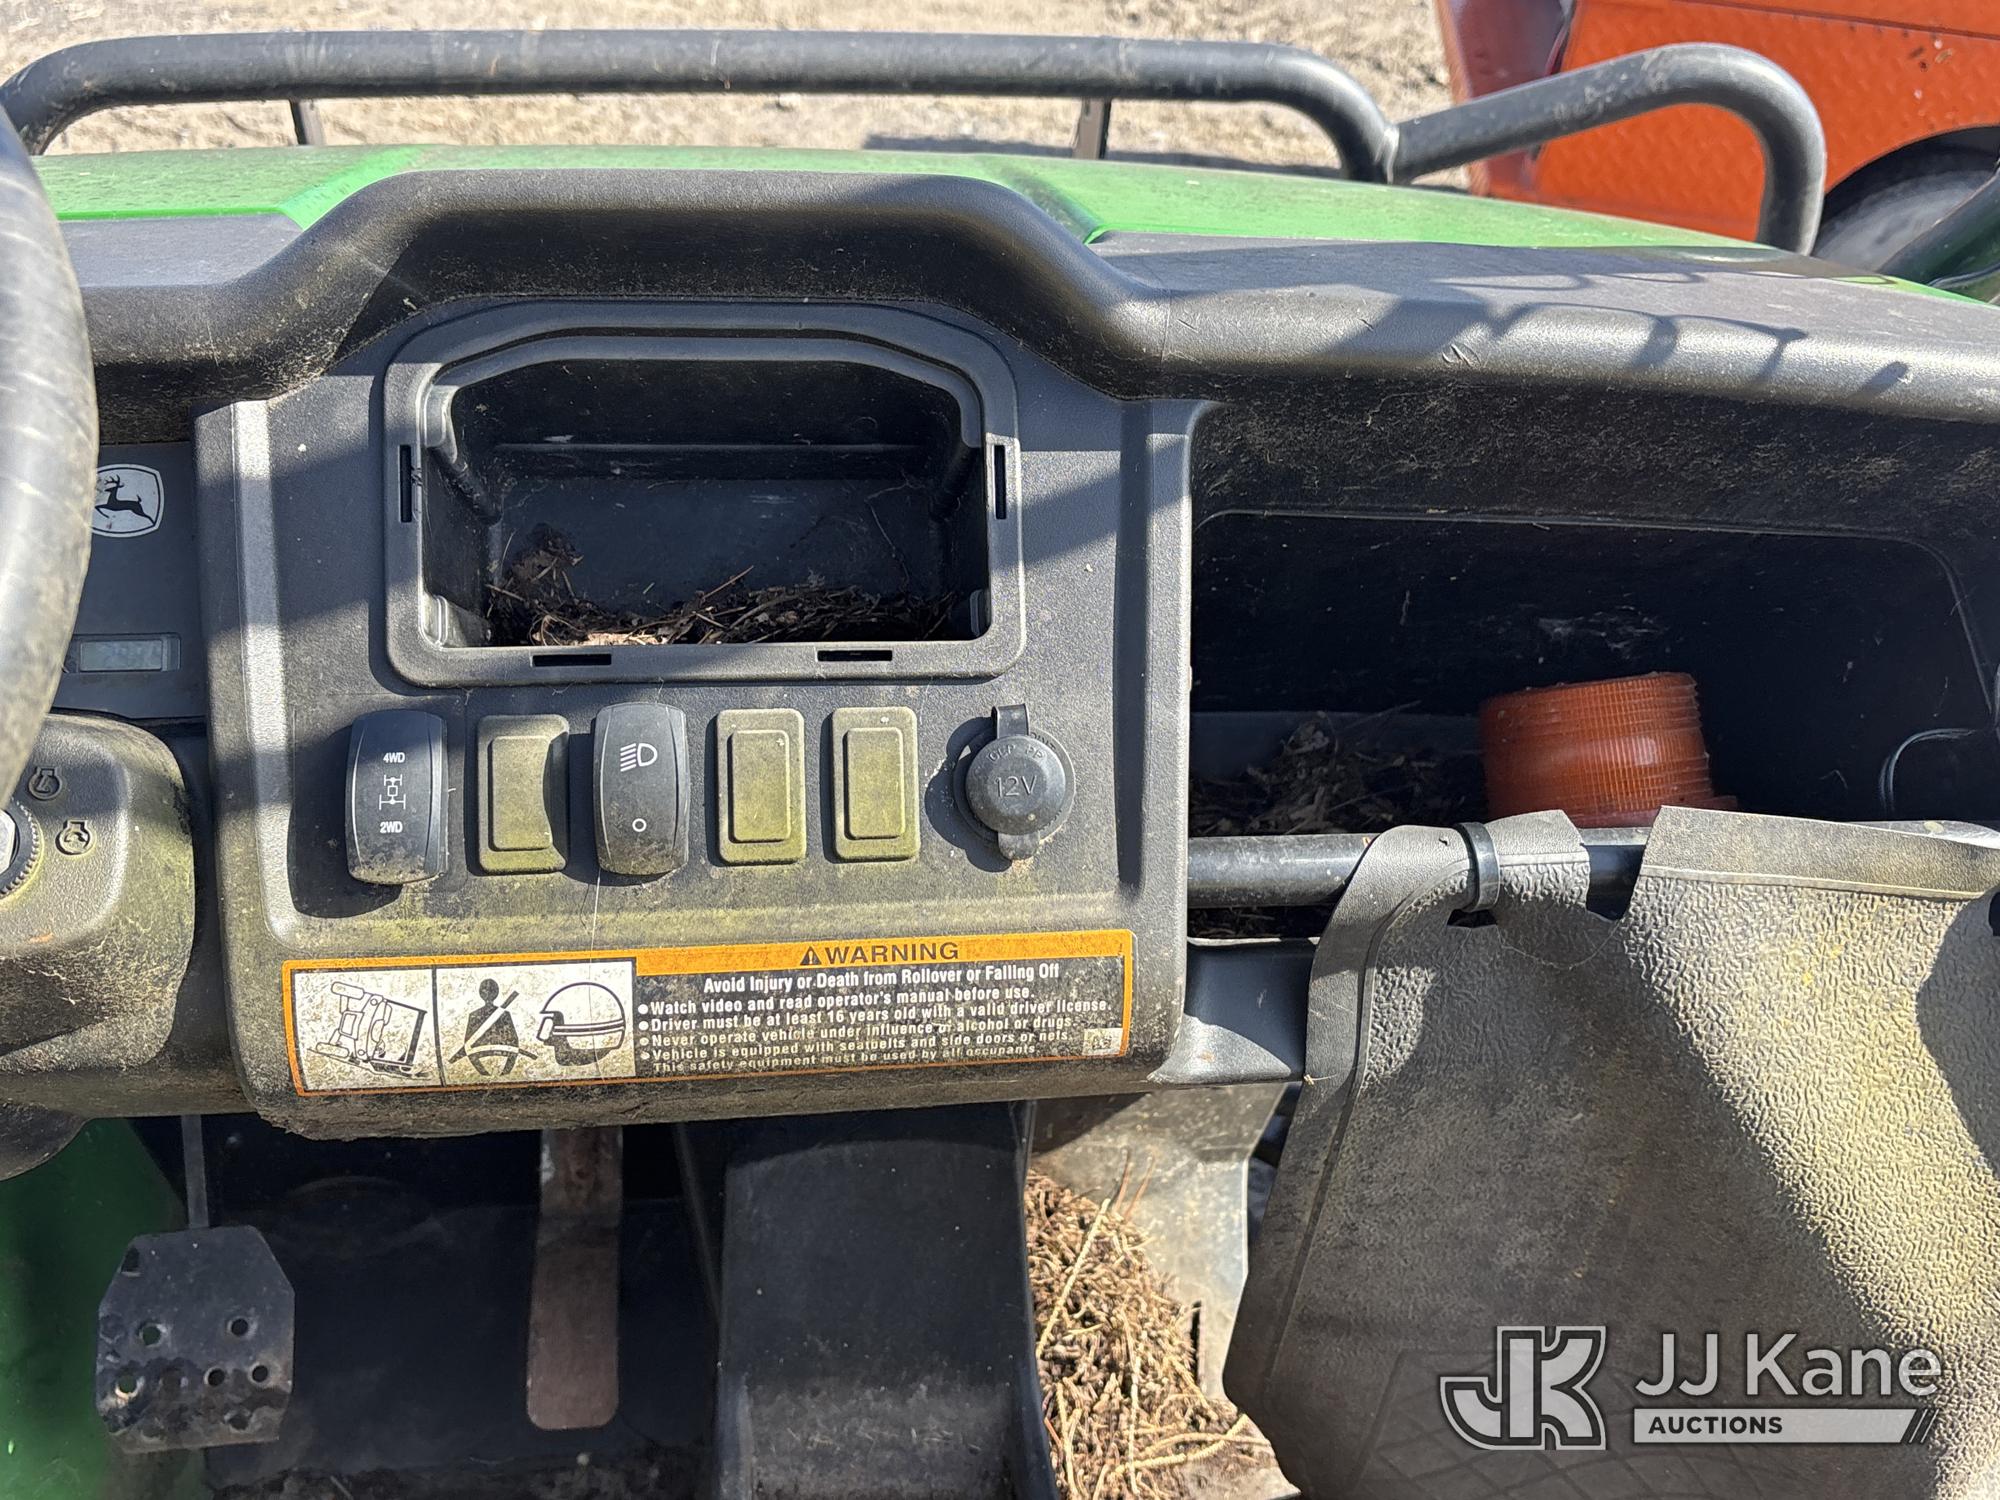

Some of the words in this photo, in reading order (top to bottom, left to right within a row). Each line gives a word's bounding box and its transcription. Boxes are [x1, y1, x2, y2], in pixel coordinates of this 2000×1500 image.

[383, 752, 405, 764] 4WD
[994, 775, 1037, 798] 12V
[380, 821, 403, 834] 2WD
[825, 942, 958, 965] WARNING
[704, 976, 745, 993] Avoid
[750, 975, 792, 993] Injury
[796, 976, 813, 990] or
[817, 971, 859, 988] Death
[863, 970, 897, 986] from
[902, 967, 961, 985] Rollover
[966, 967, 981, 982] or
[985, 964, 1035, 982] Falling
[1039, 963, 1060, 978] Off
[650, 1000, 697, 1016] Watch
[702, 998, 743, 1013] video
[747, 996, 774, 1011] and
[779, 995, 813, 1009] read
[818, 991, 891, 1010] operator's
[896, 987, 949, 1004] manual
[954, 986, 999, 1001] before
[1005, 987, 1035, 999] use.
[652, 1018, 698, 1032] Driver
[703, 1016, 738, 1029] must
[743, 1014, 760, 1027] be
[767, 1012, 781, 1025] at
[786, 1010, 822, 1026] least
[827, 1009, 845, 1023] 16
[849, 1010, 890, 1028] years
[894, 1006, 916, 1019] old
[922, 1004, 951, 1019] with
[956, 1006, 964, 1017] a
[970, 1001, 1004, 1016] valid
[1010, 1000, 1052, 1015] driver
[1056, 998, 1112, 1012] license.
[652, 1034, 694, 1047] Never
[701, 1028, 757, 1048] operate
[762, 1025, 815, 1042] vehicle
[820, 1026, 862, 1039] under
[867, 1022, 933, 1036] influence
[957, 1018, 1009, 1032] alcohol
[1014, 1019, 1028, 1029] or
[653, 1048, 708, 1062] Vehicle
[714, 1047, 726, 1057] is
[731, 1042, 799, 1060] equipped
[804, 1040, 834, 1053] with
[911, 1035, 936, 1048] and
[941, 1034, 971, 1046] side
[976, 1031, 1014, 1044] doors
[1020, 1031, 1035, 1043] or
[653, 1062, 683, 1072] This
[690, 1058, 734, 1072] safety
[739, 1055, 816, 1071] equipment
[821, 1053, 855, 1064] must
[883, 1049, 916, 1060] used
[922, 1047, 937, 1061] by
